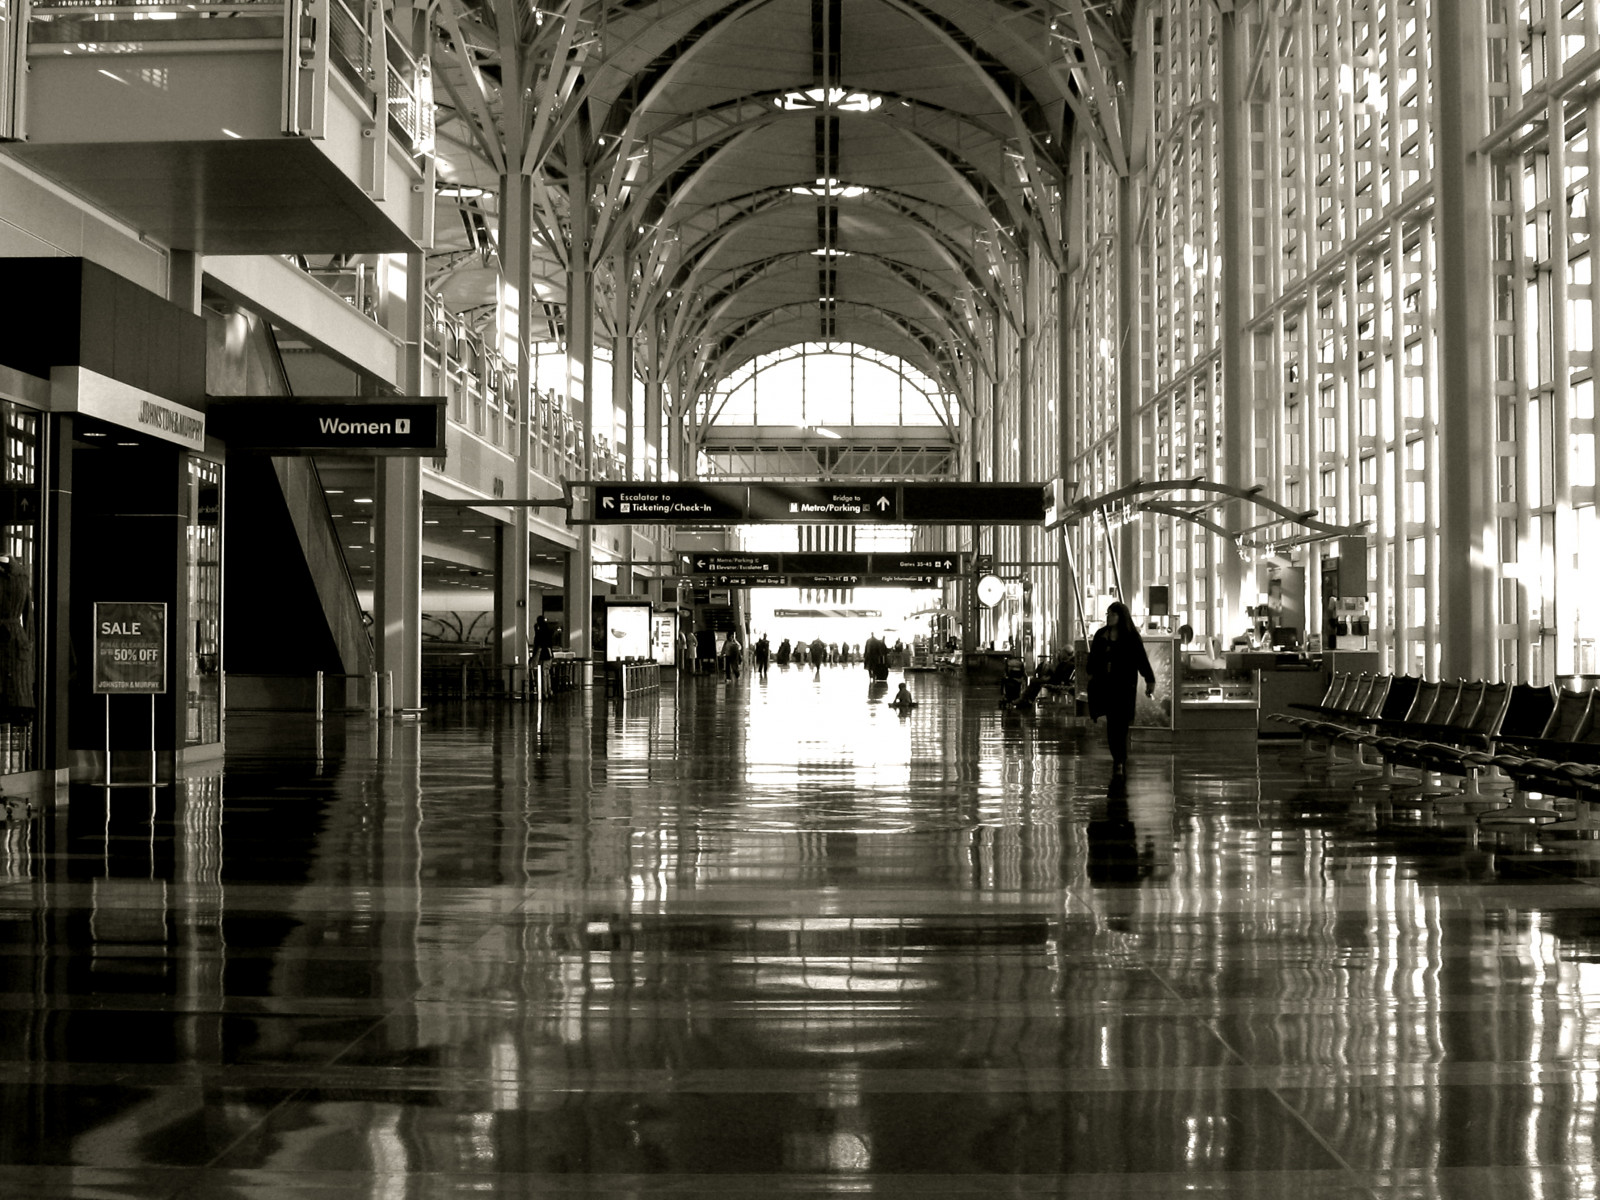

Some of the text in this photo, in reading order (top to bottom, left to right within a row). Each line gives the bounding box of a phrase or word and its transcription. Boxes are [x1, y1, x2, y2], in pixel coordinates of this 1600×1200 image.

[319, 418, 391, 434] Women
[620, 493, 658, 501] Escalator
[833, 495, 853, 503] Bridge
[632, 503, 712, 514] Ticketing/Check-In
[801, 503, 861, 514] Metro/Parking
[101, 621, 141, 635] SALE
[114, 648, 137, 661] 50%
[139, 648, 158, 661] OFF
